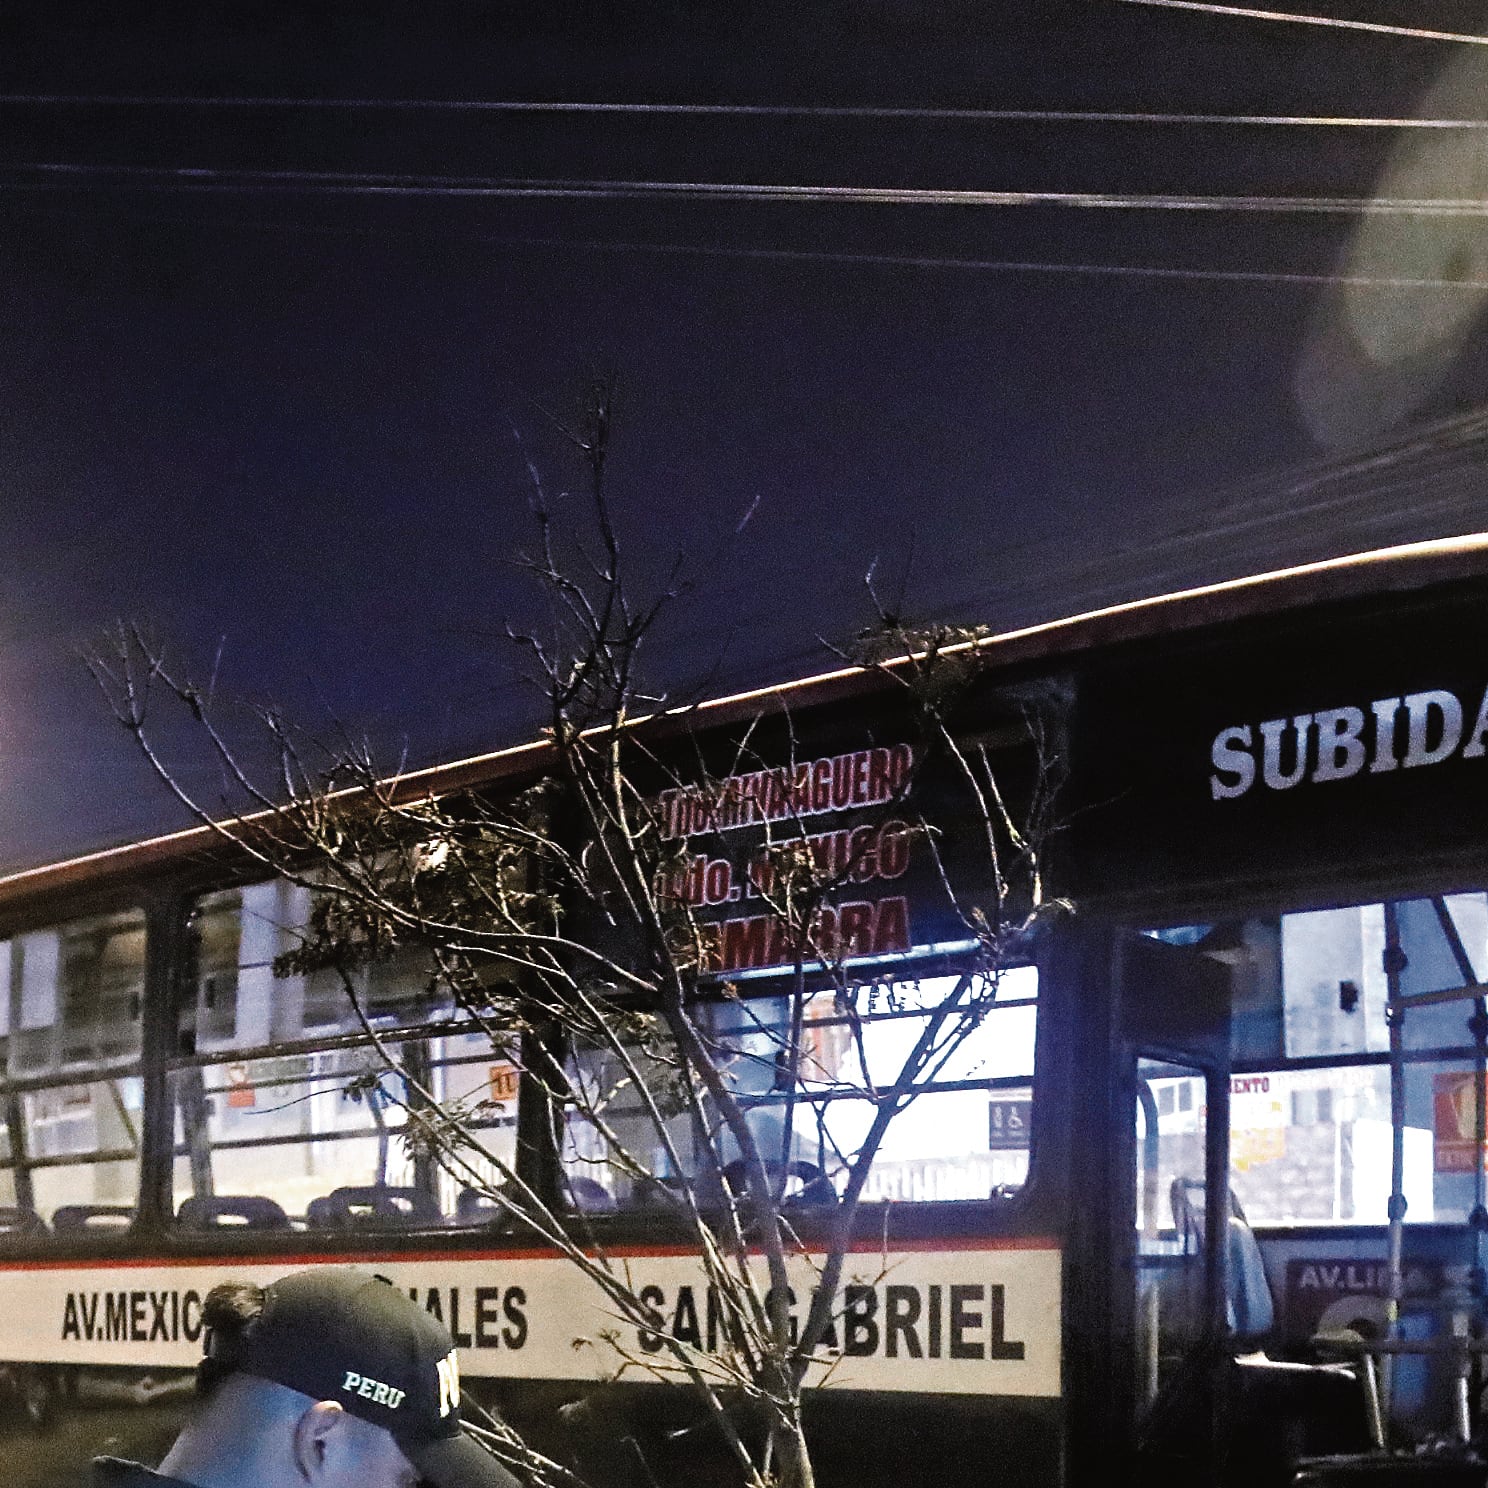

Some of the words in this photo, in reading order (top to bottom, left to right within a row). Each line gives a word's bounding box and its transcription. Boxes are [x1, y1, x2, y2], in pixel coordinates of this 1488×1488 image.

[788, 743, 913, 818] AGUERO
[745, 820, 910, 899] MXICO
[61, 1290, 213, 1343] AV.MEXIC
[409, 1285, 529, 1350] ALES
[341, 1370, 407, 1410] PERU
